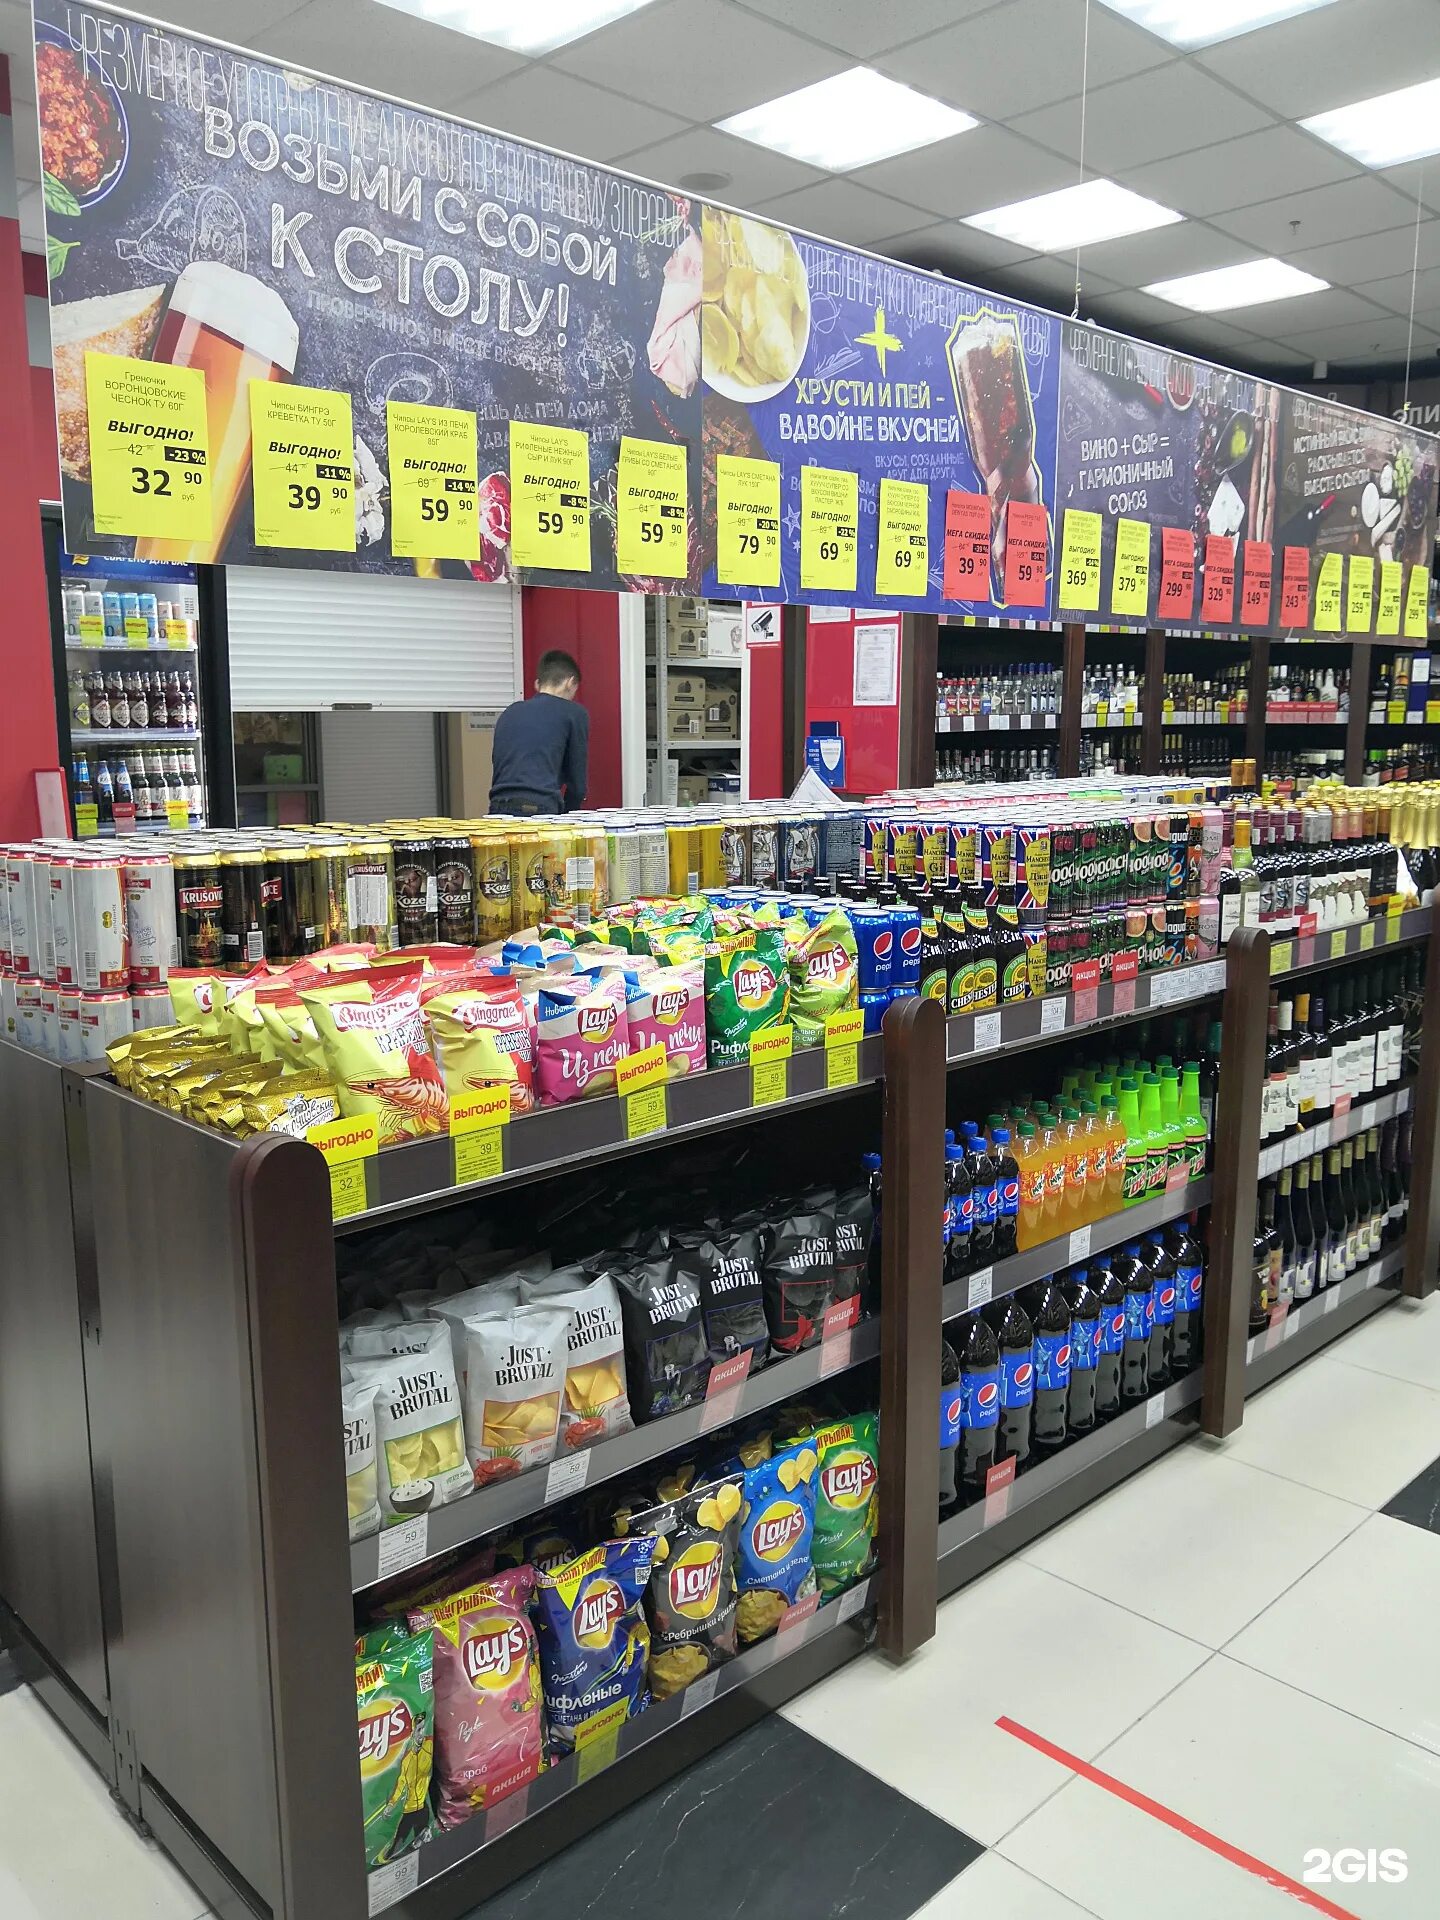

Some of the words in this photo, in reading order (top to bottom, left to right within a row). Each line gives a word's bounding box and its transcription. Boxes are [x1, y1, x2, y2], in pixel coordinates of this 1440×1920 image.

[204, 105, 421, 221] ВОЗЬМИ
[434, 187, 467, 234] С
[477, 202, 617, 286] СОБОЙ
[271, 202, 314, 278] К
[334, 225, 570, 348] СТОЛУ!
[124, 371, 166, 386] Греночки
[105, 379, 187, 401] ВОРОНЦОВСКИЕ
[795, 378, 874, 407] ХРУСТИ
[878, 382, 894, 407] И
[896, 381, 931, 409] ПЕЙ
[111, 393, 152, 408] ЧЕСНОК
[154, 399, 166, 409] ТУ
[168, 401, 185, 411] 60Г
[270, 400, 295, 411] Чипсы
[297, 403, 330, 416] БИНГРЭ
[535, 399, 564, 419] ПЕЙ
[267, 410, 310, 424] КРЕВЕТКА
[311, 416, 321, 426] ТУ
[416, 416, 437, 426] LAY'S
[438, 419, 448, 427] ИЗ
[449, 420, 469, 430] ПЕЧИ
[107, 420, 194, 442] ВЫГОДНО!
[394, 423, 449, 437] КОРОЛЕВСКИЙ
[779, 412, 874, 444] ВДВОЙНЕ
[878, 415, 960, 443] ВКУСНЕЙ
[127, 443, 143, 456] 42
[268, 441, 341, 460] ВЫГОДНО!
[1081, 437, 1118, 461] ВИНО
[1132, 433, 1158, 455] СЫР
[285, 462, 299, 474] 44
[403, 458, 467, 474] ВЫГОДНО!
[875, 454, 910, 468] ВКУСЫ,
[910, 452, 964, 467] СОЗДАННЫЕ
[131, 466, 172, 497] 32
[184, 471, 202, 485] 90
[523, 474, 580, 490] ВЫГОДНО!
[910, 468, 928, 481] ДЛЯ
[930, 467, 956, 481] ДРУГА
[1079, 455, 1174, 490] ГАРМОНИЧНЫЙ
[288, 484, 321, 511] 39
[332, 487, 348, 499] 90
[628, 487, 679, 501] ВЫГОДНО!
[1108, 489, 1148, 515] СОЮЗ
[421, 497, 449, 522] 59
[458, 499, 473, 510] 90
[727, 502, 773, 515] ВЫГОДНО!
[810, 511, 851, 523] ВЫГОДНО!
[538, 511, 564, 534] 59
[572, 514, 584, 524] 90
[886, 521, 922, 532] ВЫГОДНО!
[641, 522, 664, 543] 59
[671, 524, 682, 534] 90
[946, 528, 963, 538] МЕГА
[963, 531, 990, 541] СКИДКА!
[739, 534, 760, 555] 79
[766, 536, 776, 545] 90
[820, 541, 839, 561] 69
[844, 543, 854, 552] 90
[1008, 538, 1023, 547] МЕГА
[1023, 540, 1047, 549] СКИДКА!
[1068, 545, 1096, 554] ВЫГОДНО!
[895, 550, 912, 568] 69
[916, 551, 925, 559] 90
[959, 557, 975, 575] 39
[979, 558, 987, 567] 90
[1018, 565, 1032, 581] 59
[1066, 570, 1087, 586] 369
[1118, 577, 1136, 592] 379
[1165, 582, 1183, 597] 299
[1208, 587, 1224, 601] 329
[1246, 591, 1261, 605] 149
[1285, 595, 1299, 608] 243
[1075, 969, 1097, 981] АКЦИЯ
[1115, 960, 1136, 972] АКЦИЯ
[463, 1005, 516, 1024] Binggrae
[827, 1022, 862, 1036] ВЫГОДНО
[752, 1036, 790, 1053] ВЫГОДНО
[620, 1056, 664, 1082] ВЫГОДНО
[453, 1100, 508, 1120] ВЫГОДНО
[647, 1102, 658, 1112] 59
[480, 1143, 492, 1155] 39
[339, 1177, 353, 1190] 32
[797, 1236, 831, 1254] JUST
[717, 1256, 751, 1277] JUST
[710, 1269, 762, 1295] BRUTAL
[651, 1283, 681, 1307] JUST
[648, 1292, 701, 1325] BRUTAL
[828, 1306, 854, 1326] АКЦИЯ
[574, 1305, 608, 1332] JUST
[567, 1320, 621, 1351] BRUTAL
[506, 1344, 546, 1367] JUST
[494, 1362, 554, 1386] BRUTAL
[714, 1361, 745, 1383] АКЦИЯ
[397, 1370, 440, 1399] JUST
[389, 1387, 453, 1421] BRUTAL
[817, 1424, 854, 1449] ИГРЫВАЙ!
[569, 1463, 580, 1474] 59
[828, 1459, 872, 1497] Lay's
[990, 1466, 1012, 1483] АКЦИЯ
[404, 1531, 417, 1543] 59
[758, 1511, 801, 1552] Lay's
[675, 1552, 722, 1605] Lay's
[579, 1588, 619, 1636] Lay's
[467, 1625, 523, 1678] Lay's
[546, 1682, 622, 1712] ифленые
[359, 1705, 406, 1760] ay's
[580, 1706, 625, 1740] ВЫГОДНО
[491, 1764, 532, 1796] АКЦИЯ
